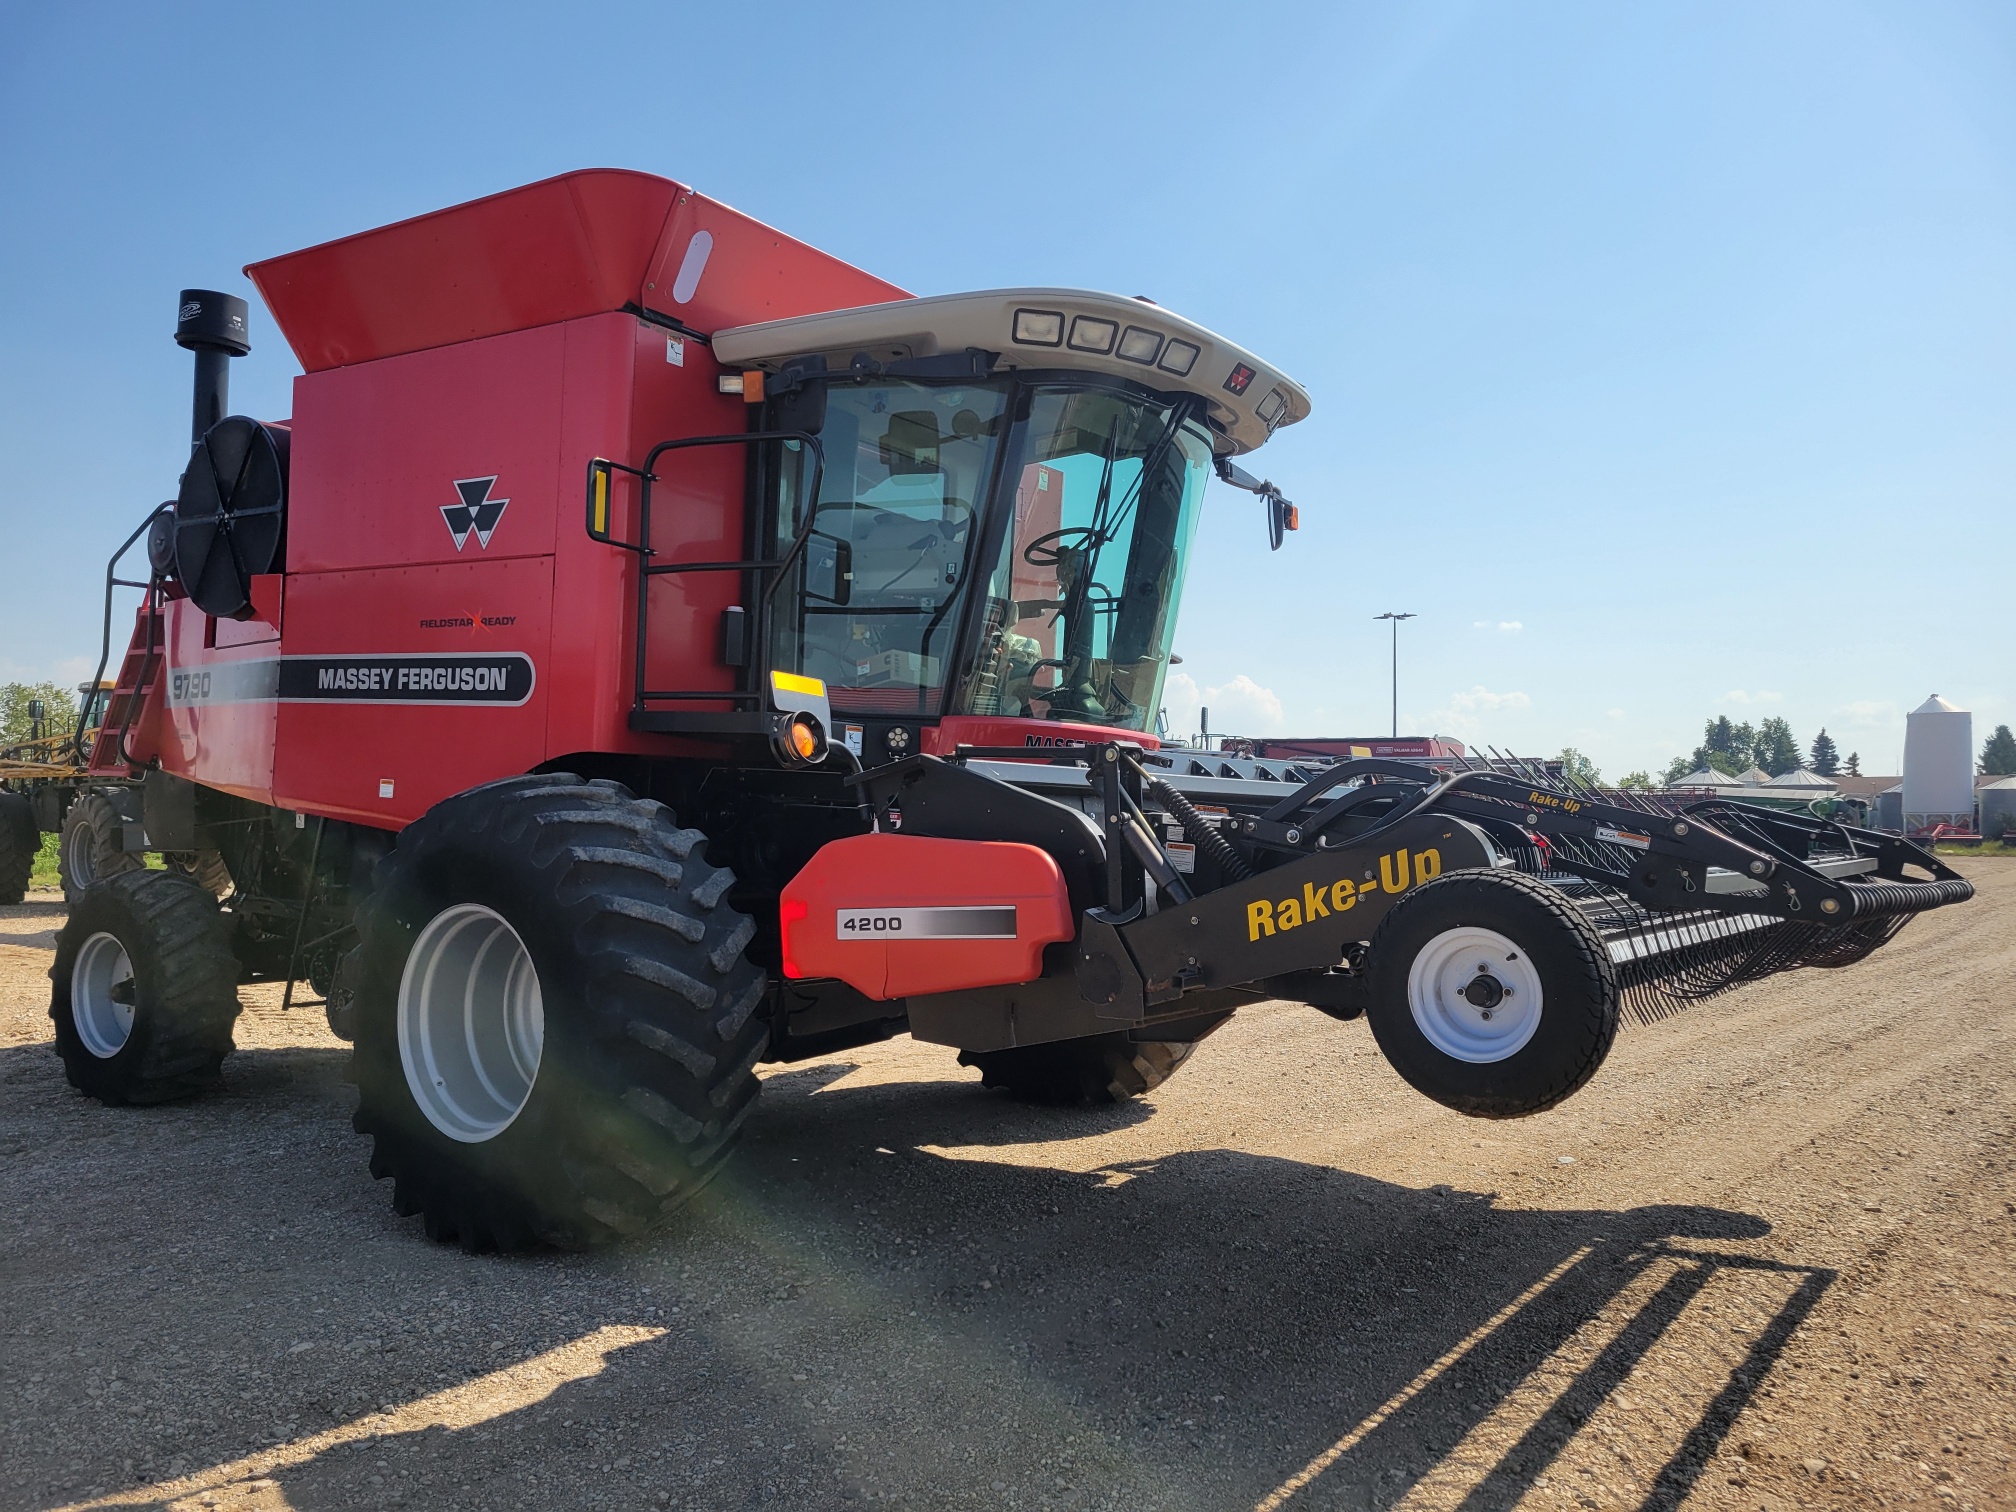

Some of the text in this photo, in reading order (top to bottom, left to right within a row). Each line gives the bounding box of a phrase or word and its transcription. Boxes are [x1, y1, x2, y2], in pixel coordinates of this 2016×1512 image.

[420, 616, 517, 628] FIELDSTAR READY
[173, 672, 211, 700] 9790
[318, 667, 507, 691] MASSEY FERGUSON
[1528, 791, 1580, 813] Rake-Up
[1247, 848, 1441, 942] Rake-Up
[843, 917, 902, 932] 4200
